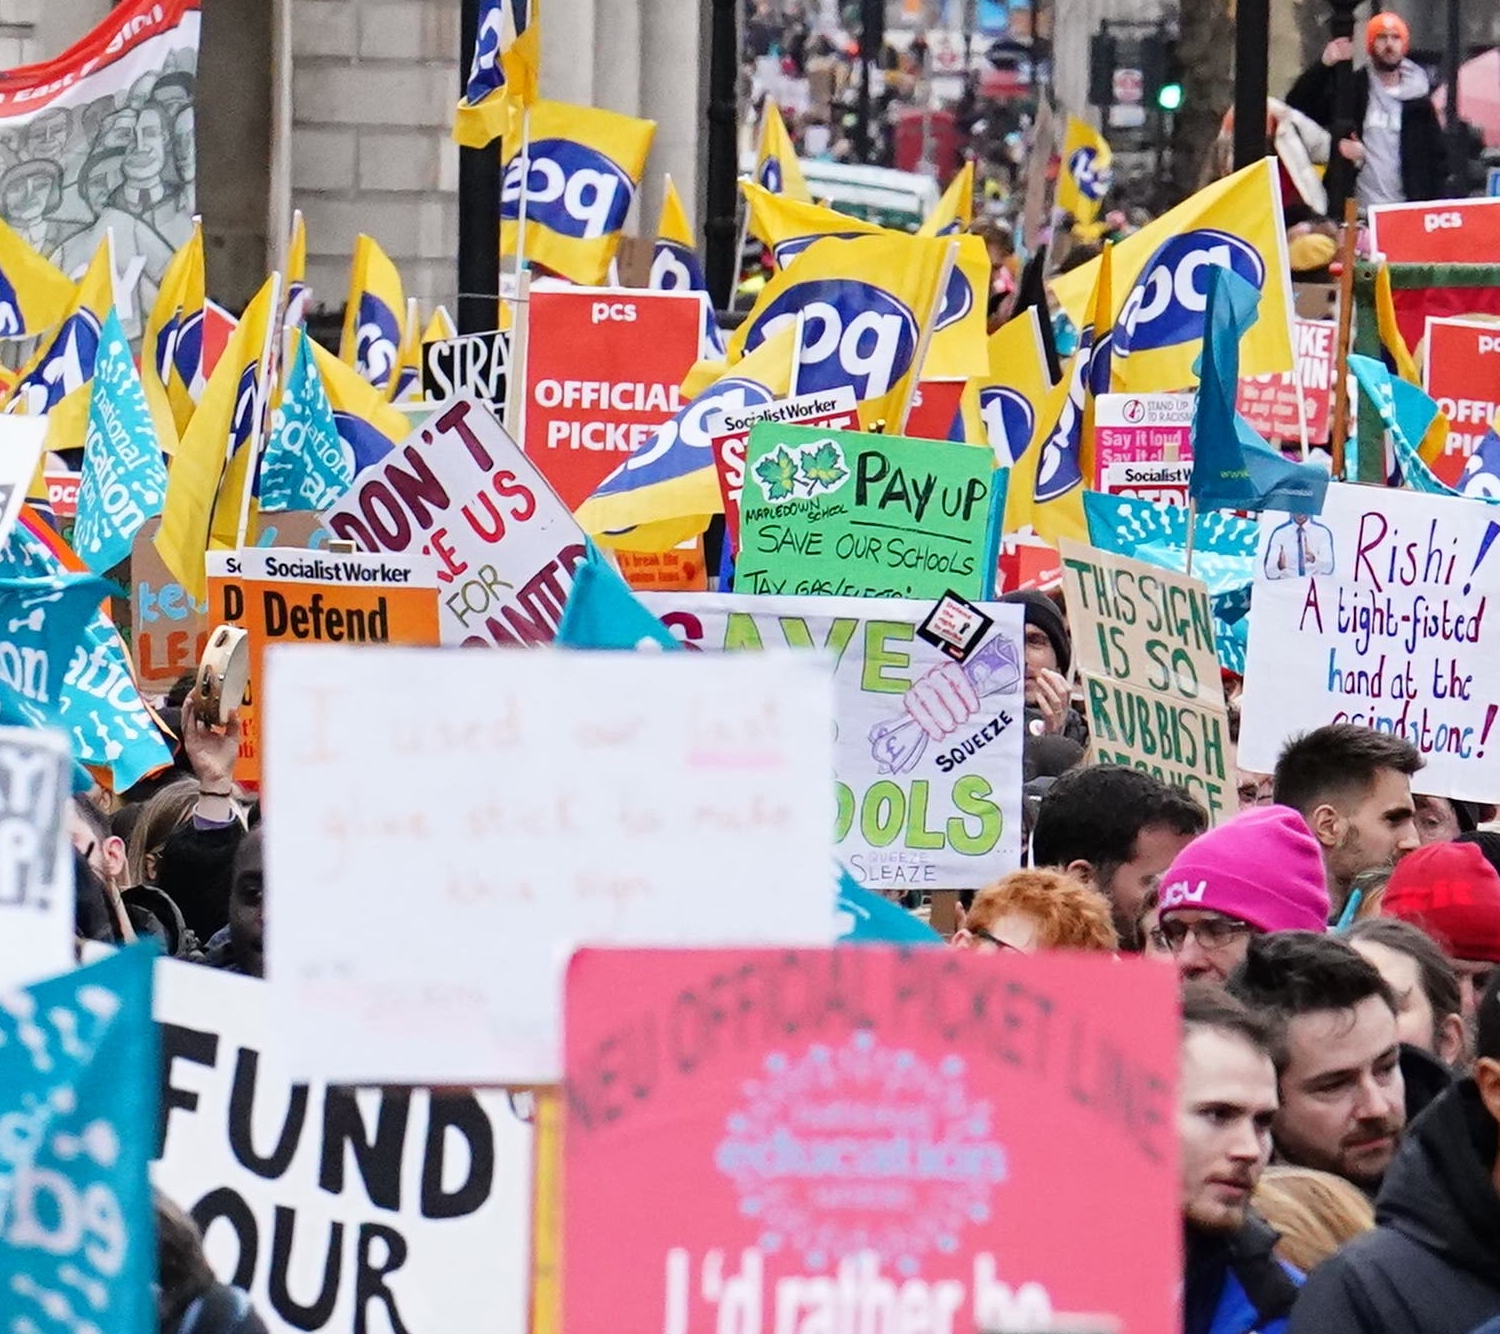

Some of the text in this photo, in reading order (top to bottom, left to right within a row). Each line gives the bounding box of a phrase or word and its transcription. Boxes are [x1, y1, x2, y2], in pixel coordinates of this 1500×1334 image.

[11, 72, 80, 105] East
[1424, 213, 1463, 232] pcs
[591, 300, 637, 324] pcs
[426, 333, 512, 404] STRA
[535, 378, 684, 413] OFFICIAL
[724, 399, 838, 432] Socialist Worker
[1147, 400, 1190, 413] STAND UP
[94, 387, 149, 469] national
[1101, 430, 1182, 450] Say it loud
[329, 400, 494, 554] DON'T
[854, 450, 938, 523] PAY
[1124, 468, 1182, 483] Socialist
[461, 470, 537, 544] US
[745, 497, 821, 524] MAPLEDOWN
[807, 504, 849, 523] SCHOOL
[265, 556, 411, 584] Socialist Worker
[757, 524, 975, 577] SAVE OUR SCHOOLS
[263, 591, 389, 641] Defend
[445, 564, 514, 628] FOR
[1062, 558, 1217, 656] THIS SIGN
[1299, 577, 1486, 661] A tight-fisted
[1095, 621, 1199, 699] IS SO
[1327, 648, 1473, 701] hand at the
[935, 710, 1014, 773] SQUEEZE
[1088, 678, 1226, 781] RUBBISH
[666, 947, 873, 1074] OFFICIAL
[896, 947, 1055, 1079] PICKET
[1070, 1022, 1168, 1165] LINE
[155, 1024, 495, 1220] FUND
